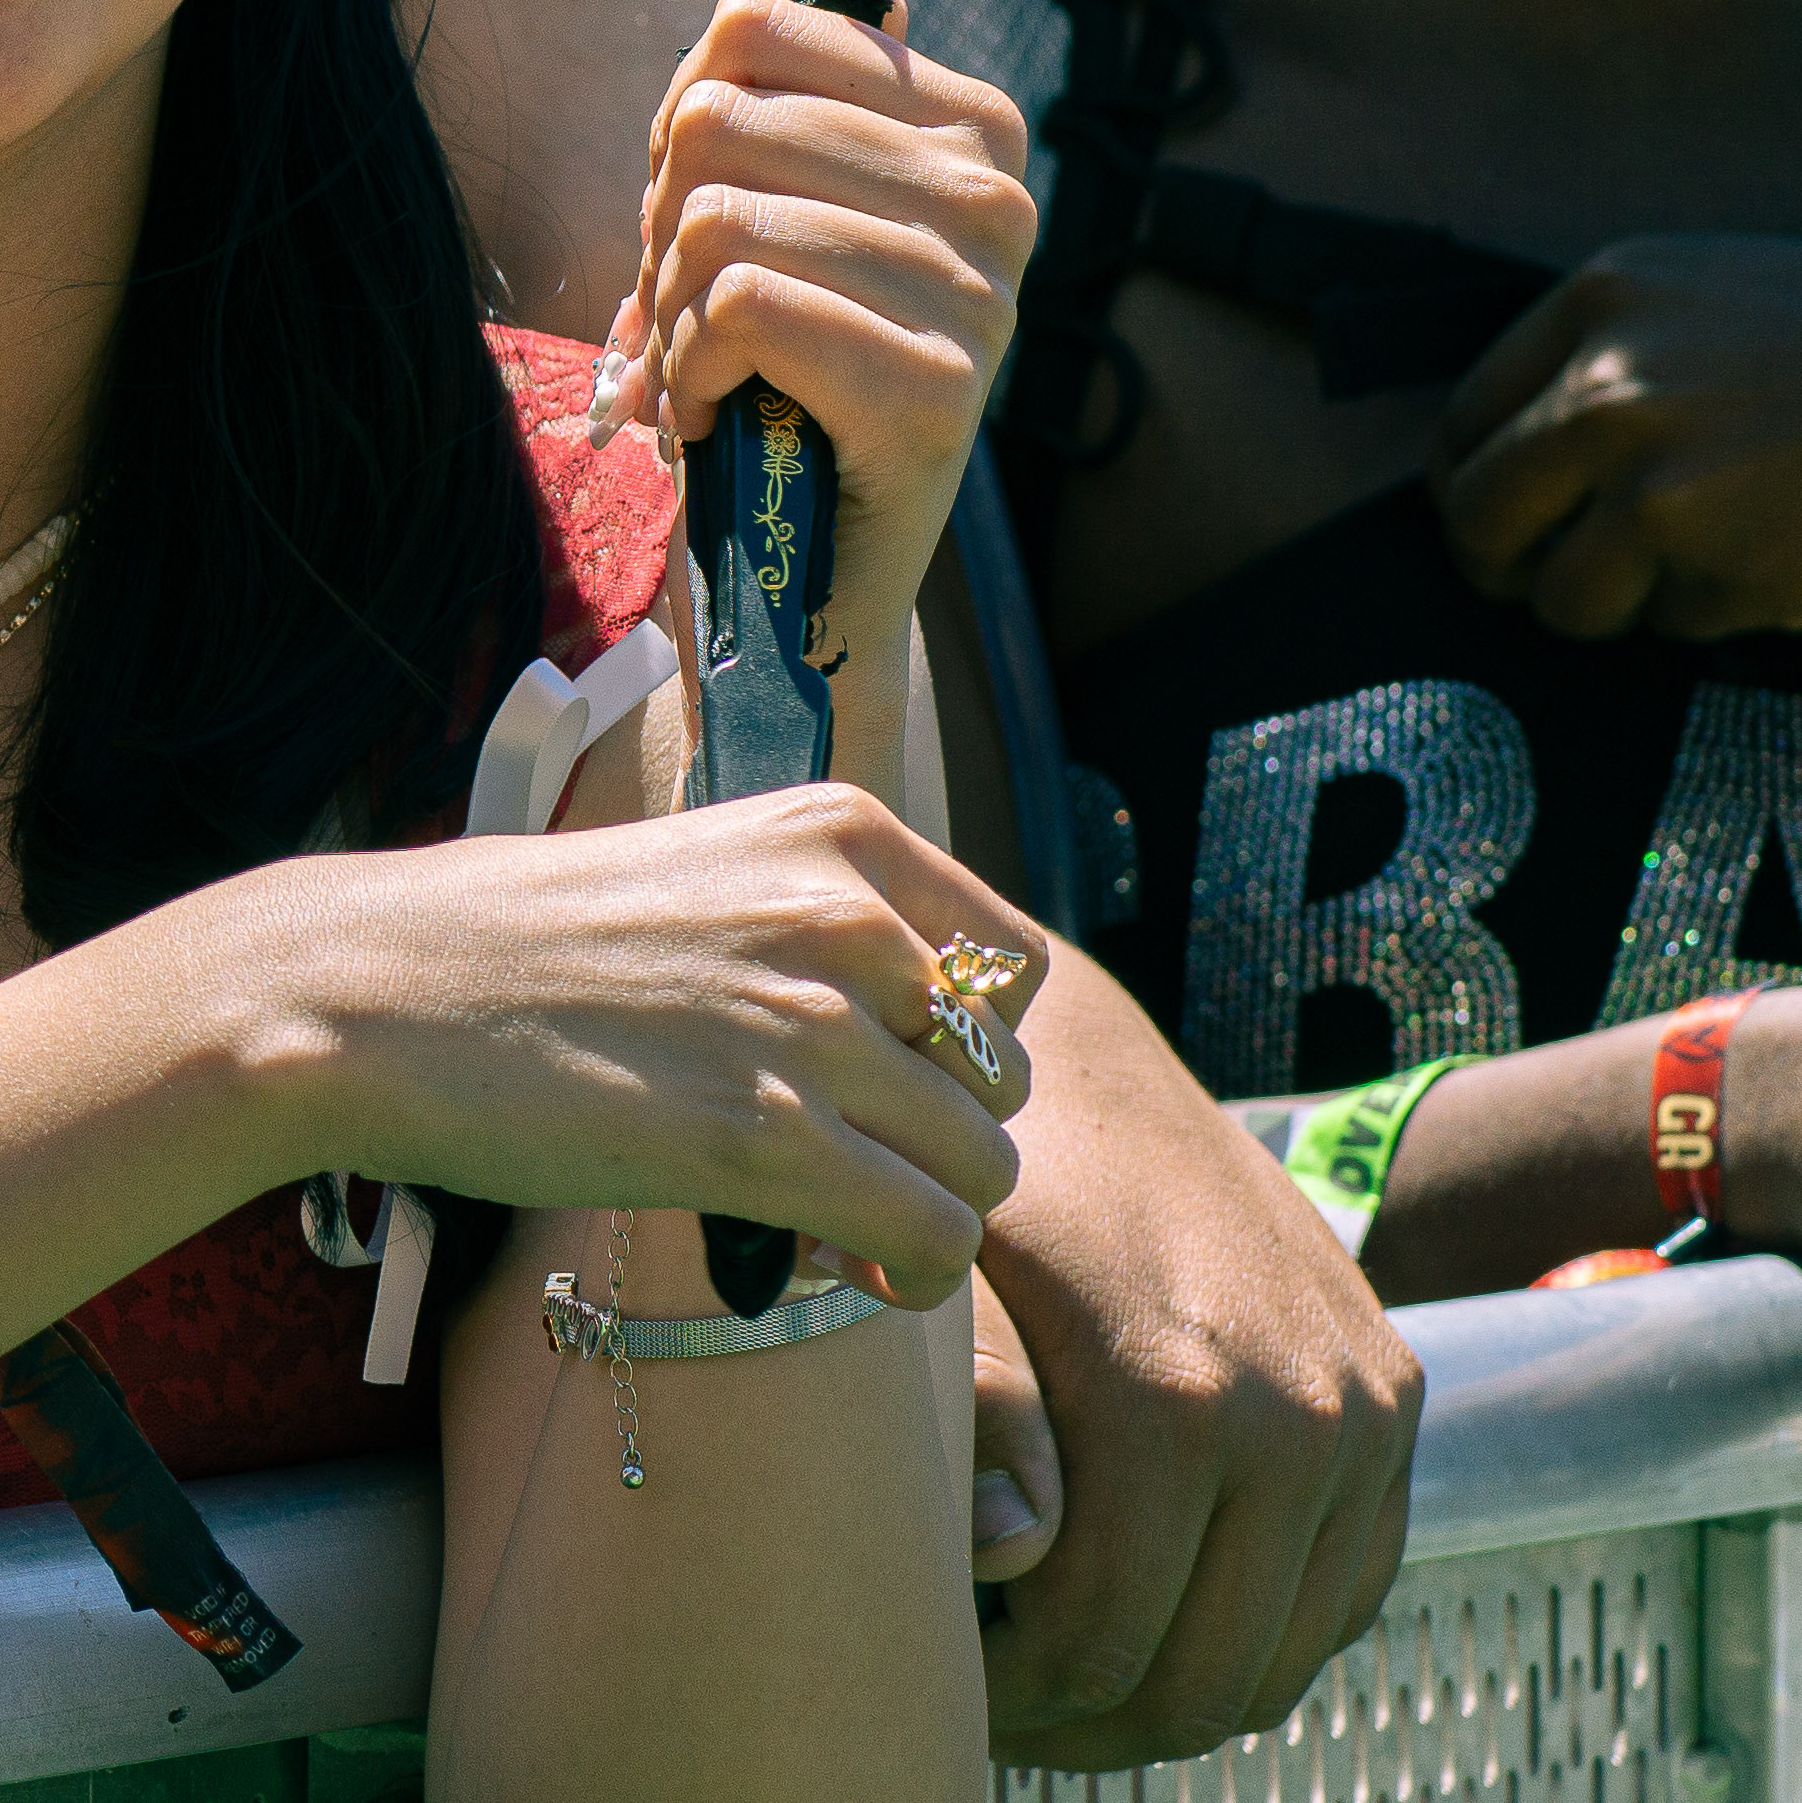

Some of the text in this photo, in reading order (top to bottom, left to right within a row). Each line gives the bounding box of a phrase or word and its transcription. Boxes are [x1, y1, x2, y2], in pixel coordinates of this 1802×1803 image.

[186, 1594, 218, 1621] VOID
[188, 1592, 250, 1643] TAMPERED
[239, 1616, 260, 1637] OR
[220, 1627, 277, 1673] REMOVED
